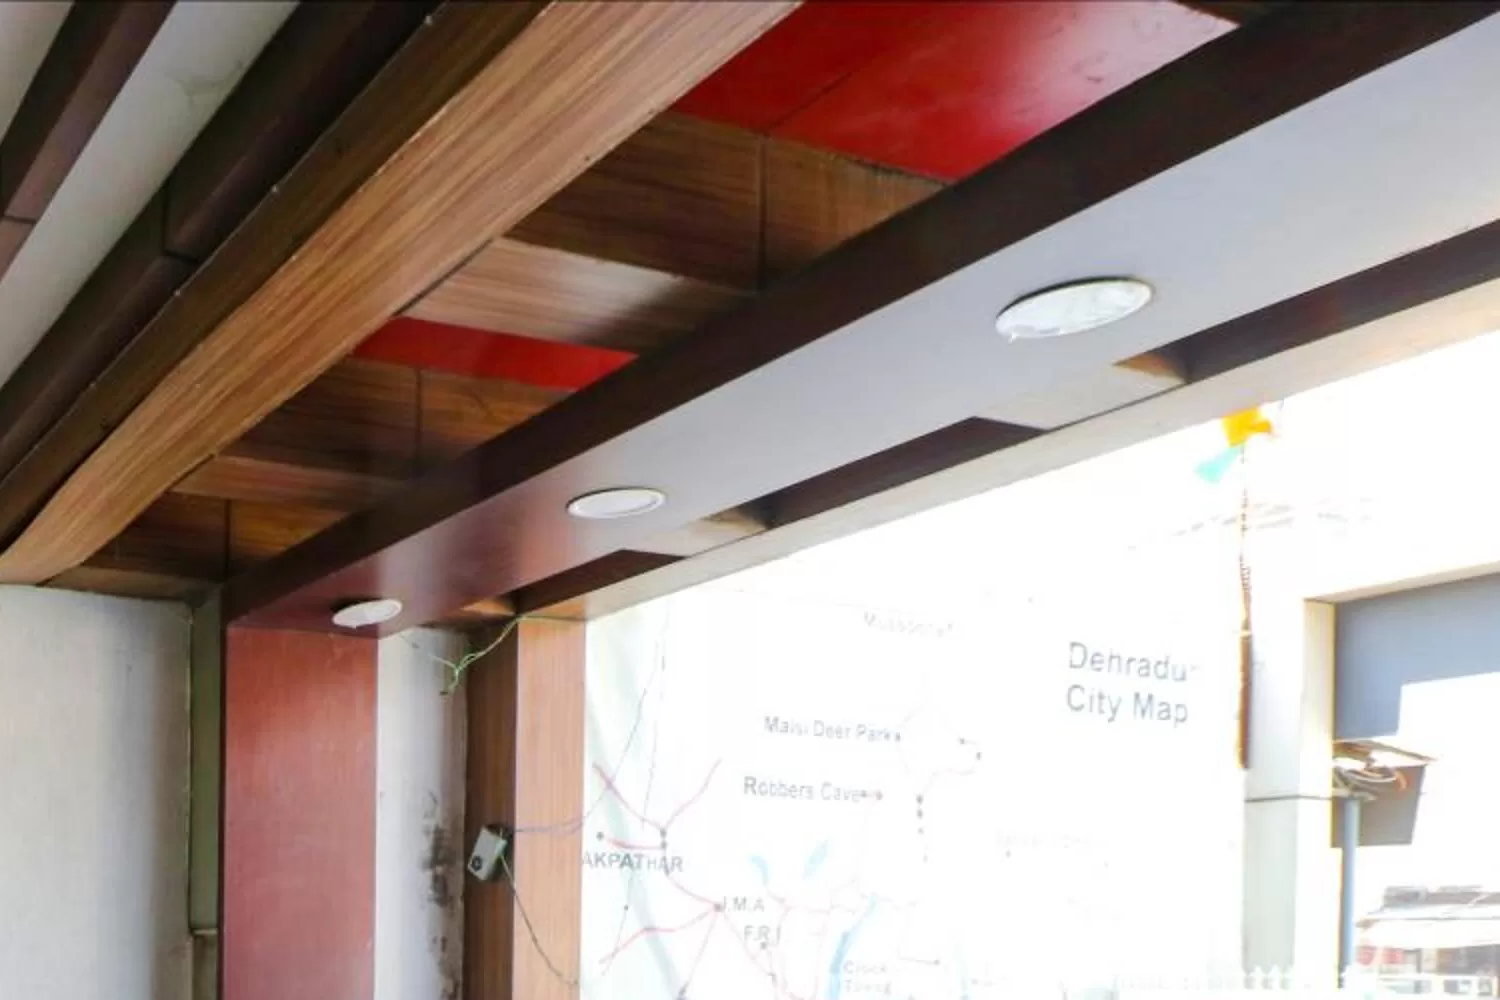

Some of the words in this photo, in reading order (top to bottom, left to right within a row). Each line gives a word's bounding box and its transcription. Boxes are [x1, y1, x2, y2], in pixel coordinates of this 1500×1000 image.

[1068, 641, 1202, 682] Dehradu
[1066, 683, 1122, 724] City
[1133, 691, 1189, 729] Map
[743, 775, 814, 799] Robbers
